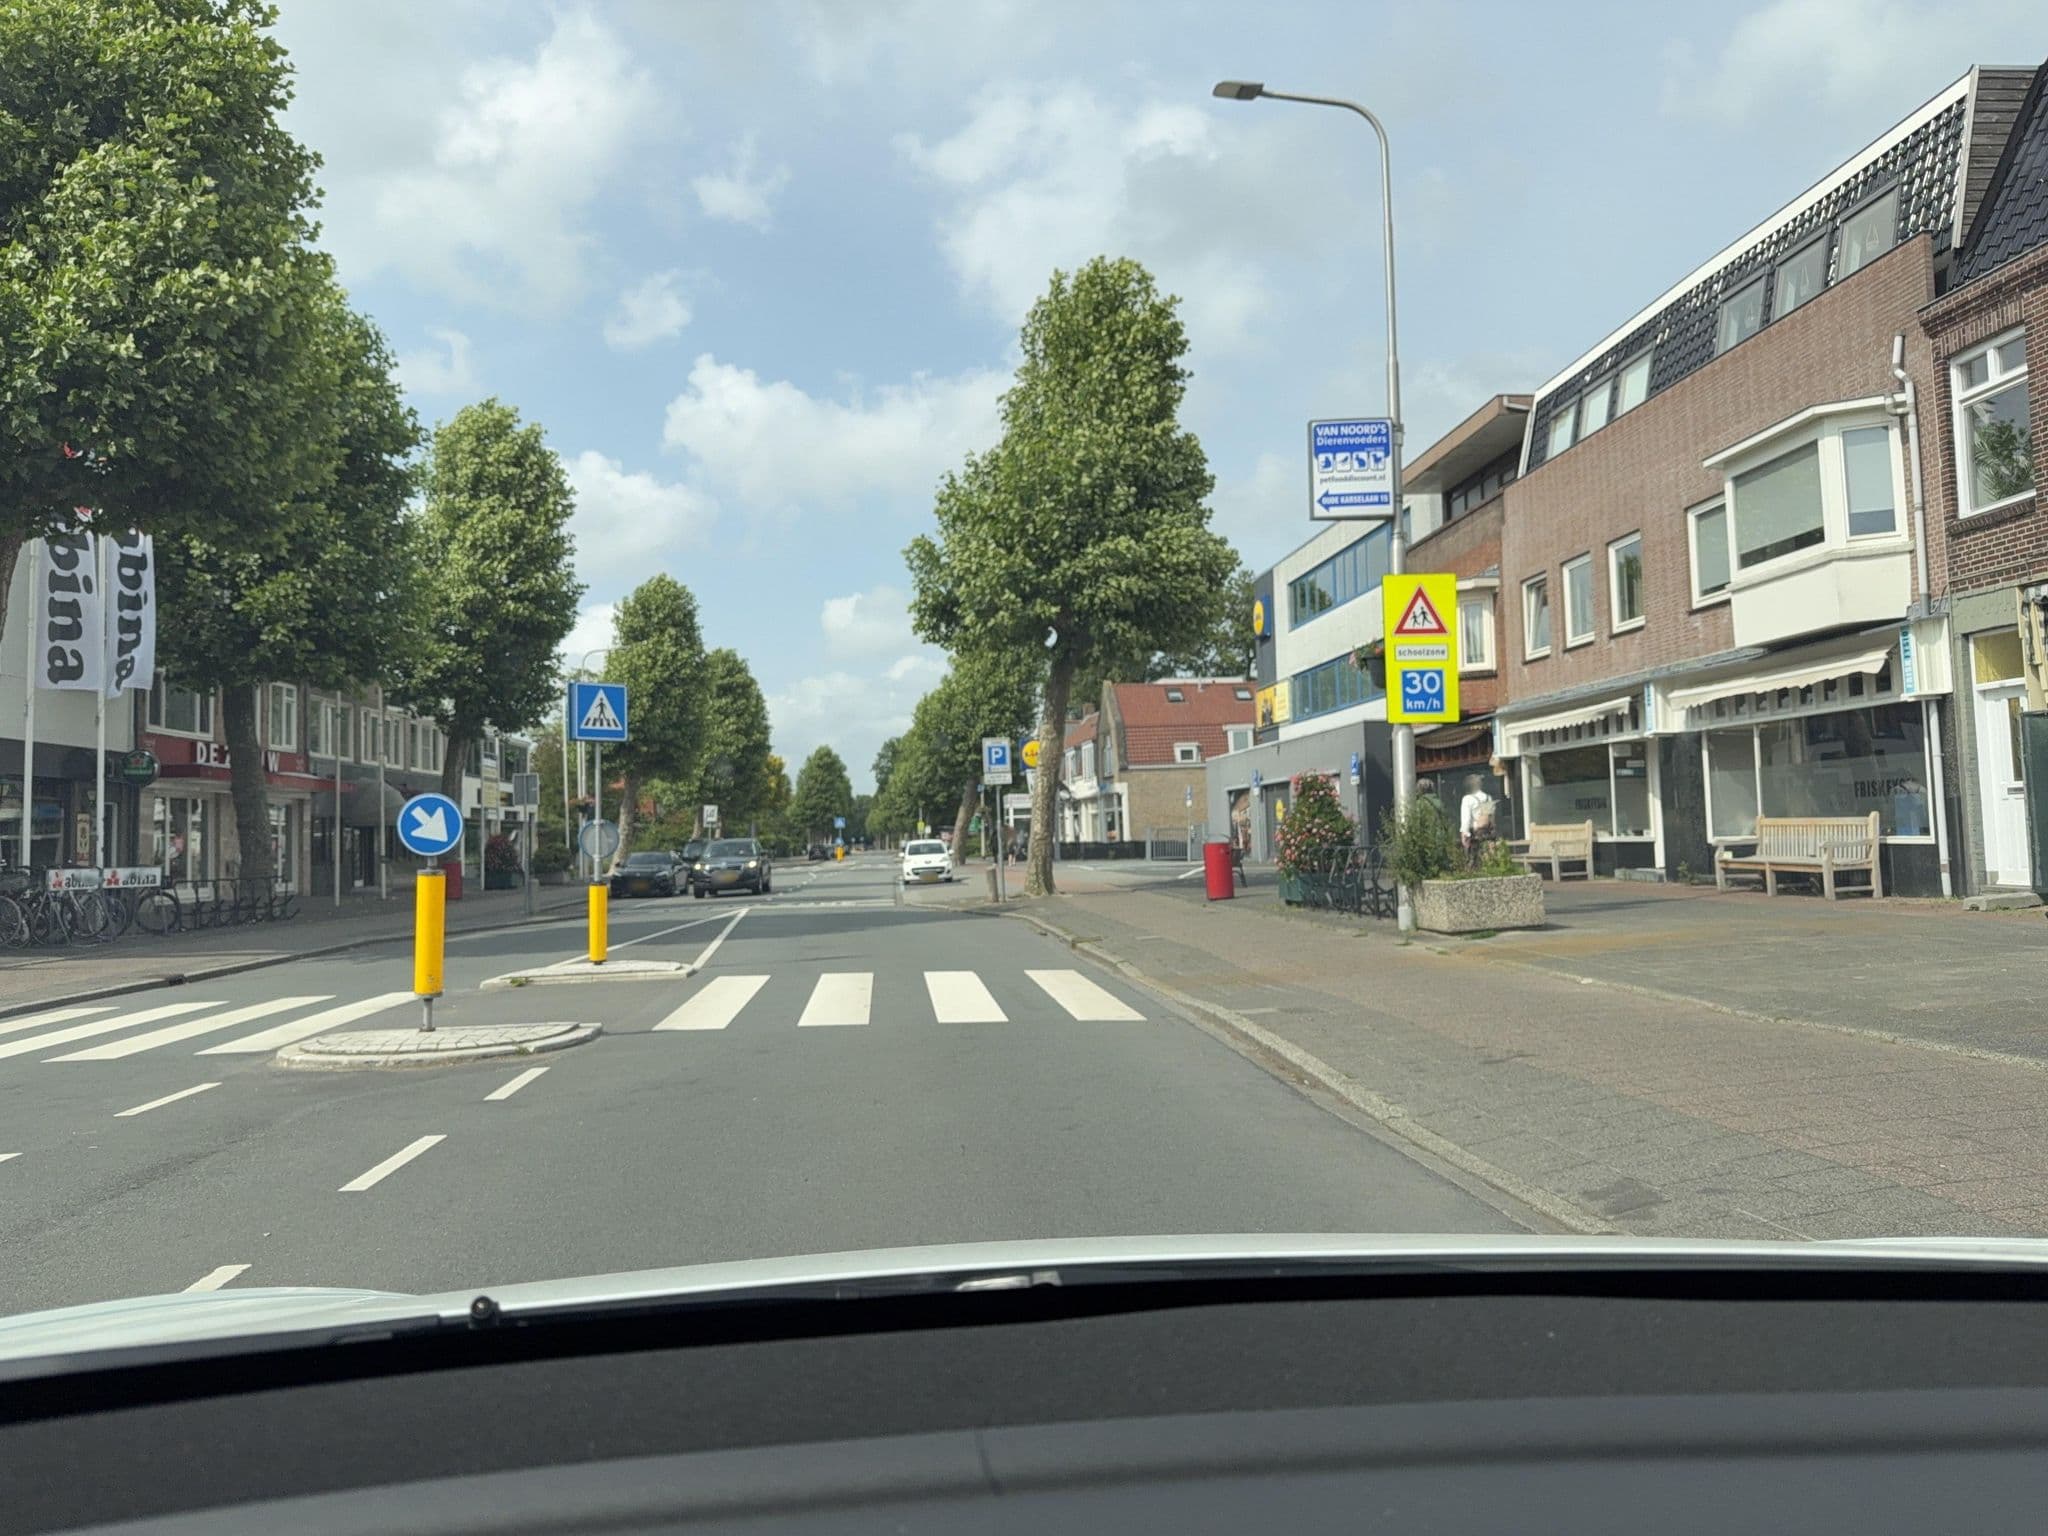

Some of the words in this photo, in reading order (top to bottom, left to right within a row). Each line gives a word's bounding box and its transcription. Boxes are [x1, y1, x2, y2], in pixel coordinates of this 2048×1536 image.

[1316, 426, 1338, 437] VAN
[1340, 423, 1387, 436] NOORD'S
[1316, 435, 1387, 446] Dierenvoeders
[1398, 647, 1446, 657] schoolzone
[1405, 671, 1440, 694] 30
[1406, 697, 1441, 710] km/h
[196, 741, 220, 767] DE
[991, 747, 1003, 764] P
